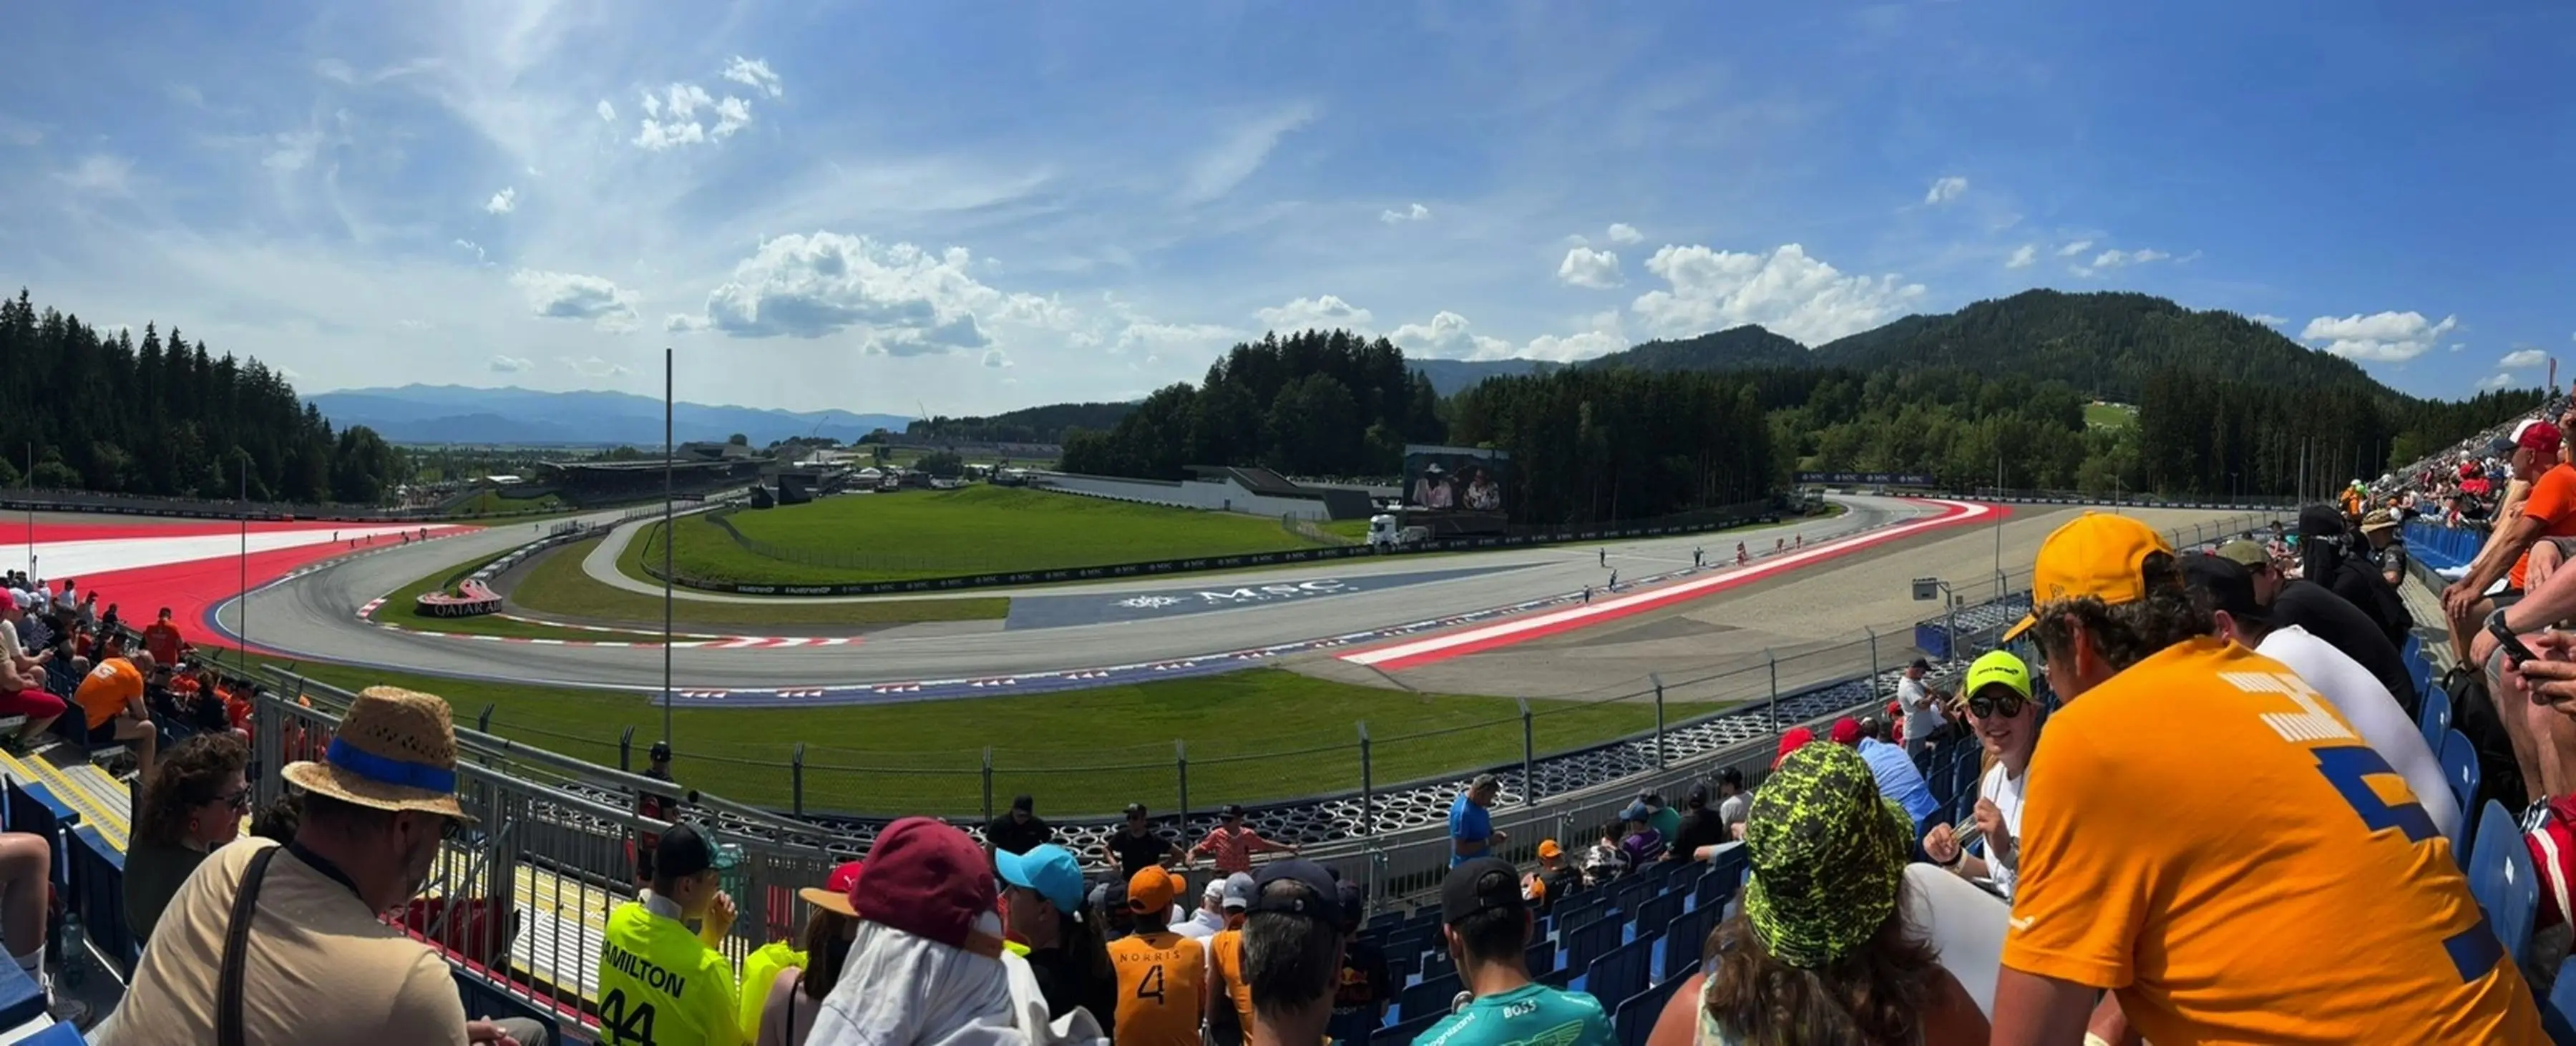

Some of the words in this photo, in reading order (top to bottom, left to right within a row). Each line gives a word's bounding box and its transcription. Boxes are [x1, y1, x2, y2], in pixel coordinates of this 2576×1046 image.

[1196, 580, 1345, 602] MSC
[434, 602, 483, 616] QATAR
[1119, 949, 1181, 963] NORRIS
[601, 940, 686, 999] AMILTON
[1137, 964, 1165, 1005] 4
[600, 988, 657, 1046] 44
[1503, 999, 1536, 1018] BOSS
